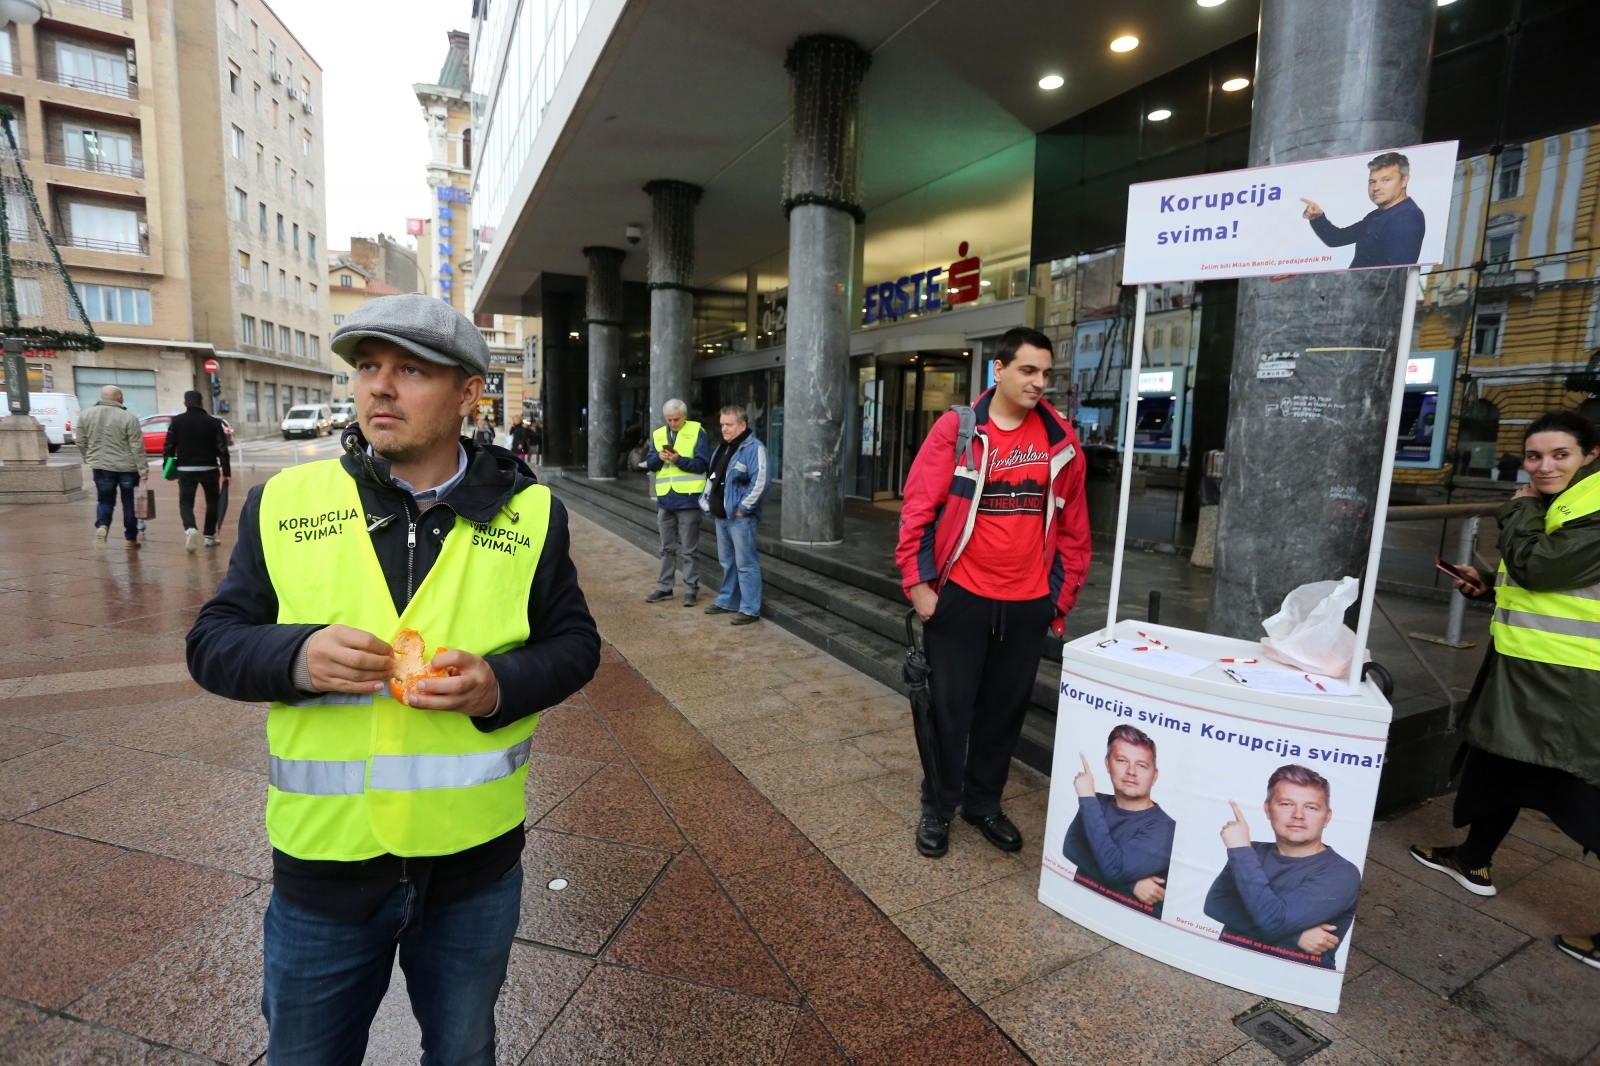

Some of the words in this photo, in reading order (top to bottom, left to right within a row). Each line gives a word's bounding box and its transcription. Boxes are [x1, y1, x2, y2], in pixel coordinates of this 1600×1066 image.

[1160, 183, 1282, 214] Korupcija
[1157, 220, 1239, 245] svima!
[438, 206, 454, 305] BONAV
[1278, 256, 1320, 266] predsjednik
[864, 266, 943, 324] ERSTE
[278, 508, 359, 532] KORUPCIJA
[294, 523, 343, 543] SVIMA!
[470, 522, 530, 549] ORUPCIJA
[472, 534, 517, 556] SVIMA!
[1060, 681, 1133, 717] Korupcija
[1138, 709, 1191, 734] svima
[1200, 723, 1301, 758] Korupcija
[1307, 747, 1383, 769] svima!
[1176, 916, 1194, 927] Dario
[1222, 931, 1253, 945] kandidat
[1263, 944, 1310, 960] predsjednika
[1310, 955, 1322, 963] RH
